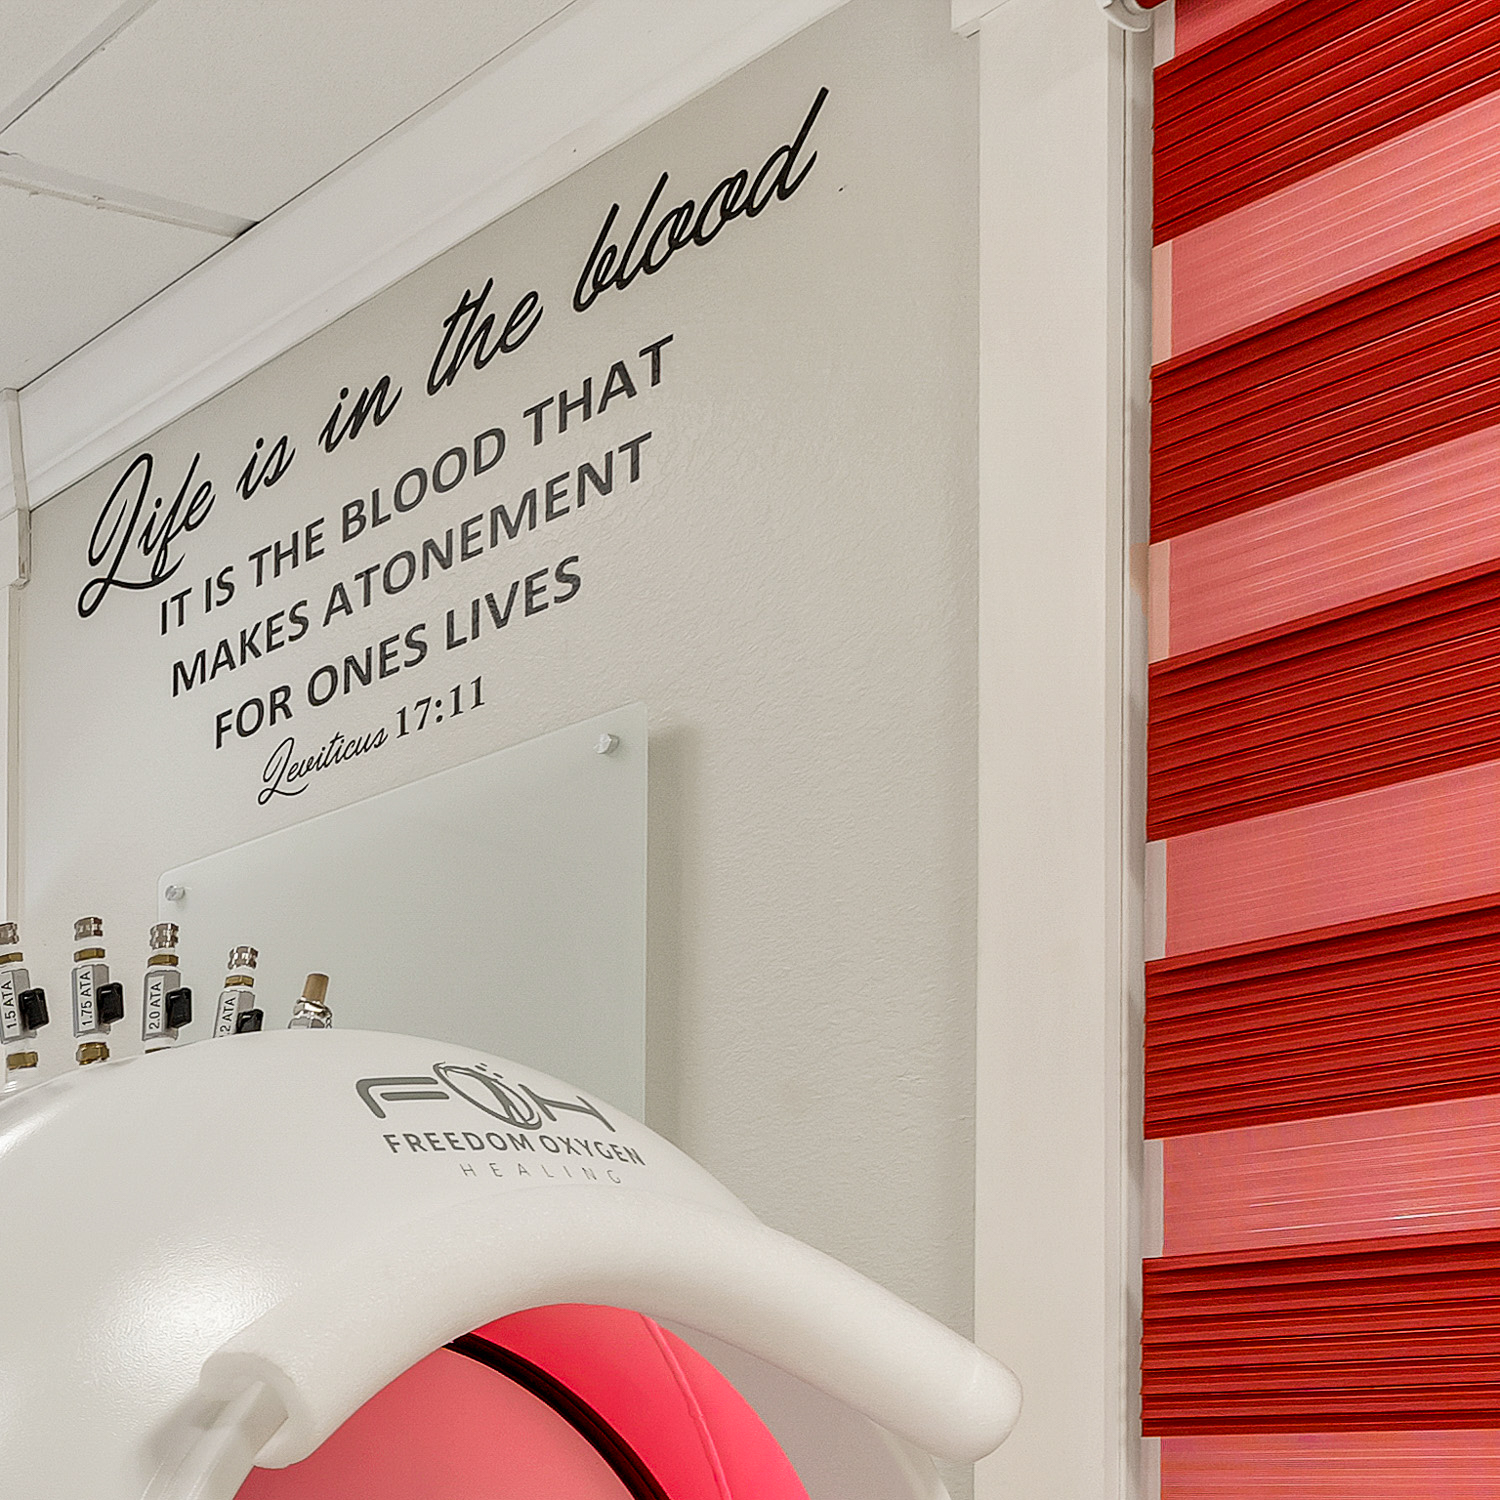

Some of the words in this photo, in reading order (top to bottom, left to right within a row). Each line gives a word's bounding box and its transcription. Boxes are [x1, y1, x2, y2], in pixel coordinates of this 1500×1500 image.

[78, 453, 215, 618] Life
[237, 438, 295, 500] is
[318, 376, 402, 452] in
[427, 278, 543, 396] the
[573, 87, 829, 312] blood
[160, 588, 192, 635] IT
[205, 567, 235, 614] IS
[249, 518, 325, 587] THE
[342, 427, 506, 543] BLOOD
[523, 334, 674, 446] THAT
[172, 599, 309, 698] MAKES
[323, 431, 653, 626] ATONEMENT
[215, 685, 292, 749] FOR
[308, 624, 428, 706] ONES
[446, 555, 581, 650] LIVES
[258, 736, 388, 805] Leviticus
[396, 675, 486, 738] 17:11
[1, 980, 14, 1007] ATA
[80, 971, 93, 997] ATA
[150, 982, 162, 1007] ATA
[5, 1010, 17, 1029] 1.5
[81, 1001, 93, 1026] 1.75
[148, 1011, 161, 1030] 2.0
[222, 997, 236, 1022] ATA
[383, 1132, 535, 1154] FREEDOM
[539, 1135, 646, 1166] OXYGEN
[459, 1162, 621, 1184] HEALING
